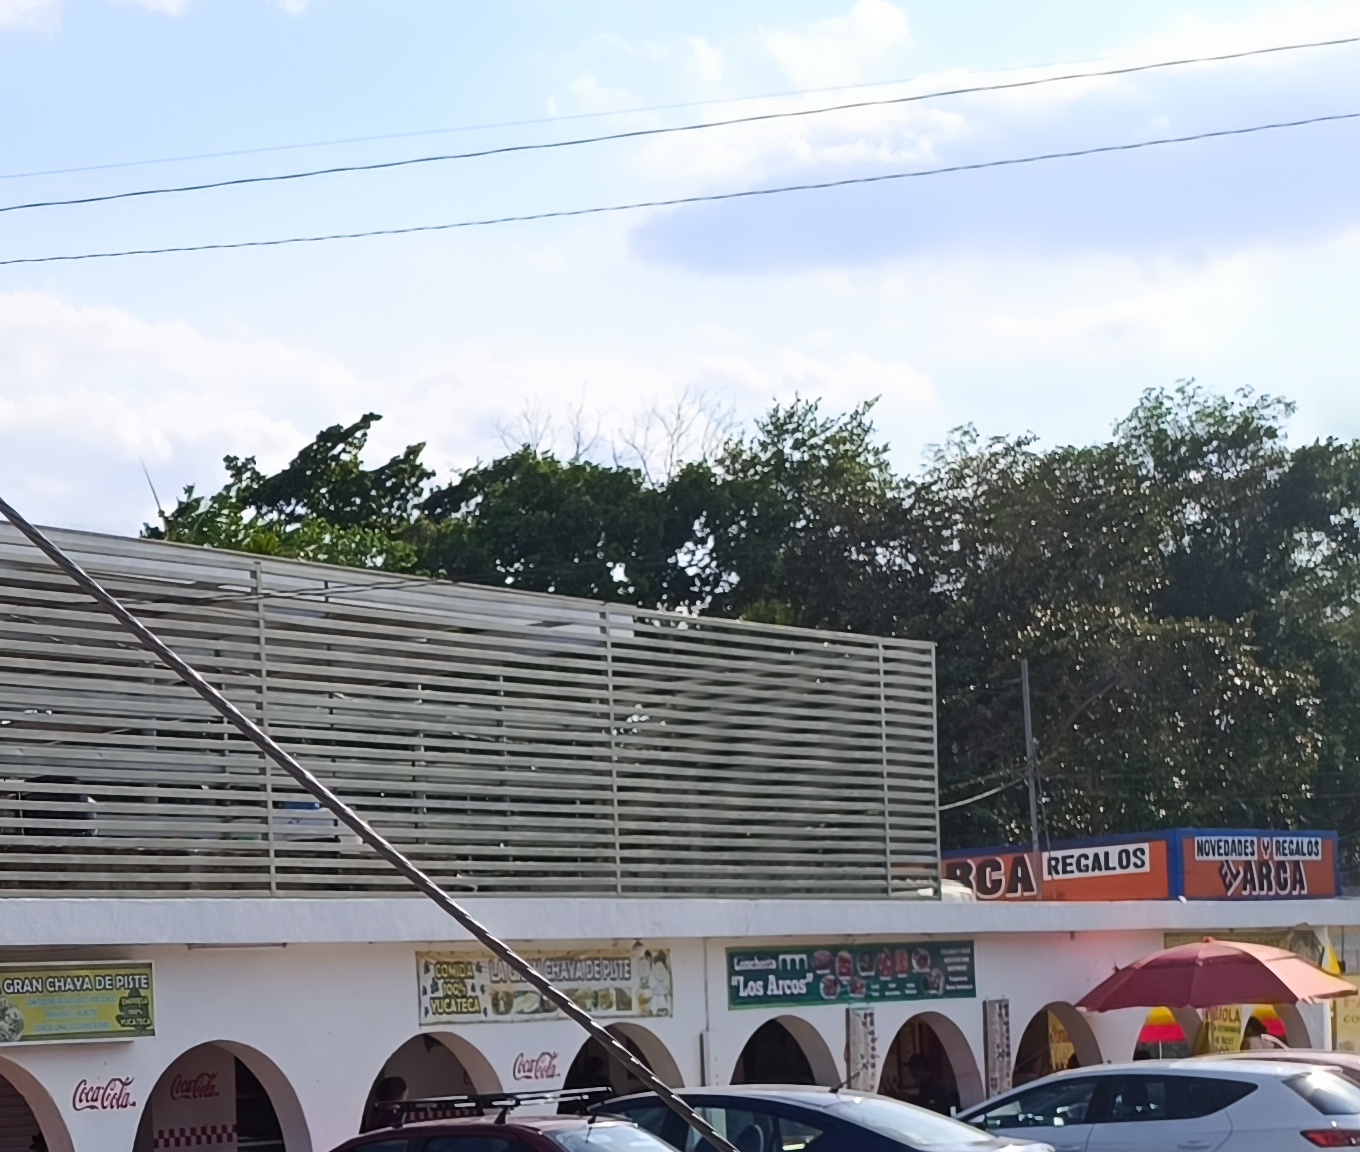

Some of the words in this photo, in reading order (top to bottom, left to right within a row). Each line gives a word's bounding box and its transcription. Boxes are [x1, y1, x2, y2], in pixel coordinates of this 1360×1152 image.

[1197, 838, 1256, 857] NOVEDADES
[1261, 838, 1271, 858] Y
[1275, 838, 1320, 857] REGALOS
[1047, 847, 1146, 876] REGALOS
[946, 854, 1038, 899] RCA
[1242, 859, 1308, 896] ARCA
[434, 962, 475, 979] COMIDA
[544, 958, 584, 982] CHAYA
[584, 957, 600, 981] DE
[2, 976, 43, 994] GRAN
[46, 975, 93, 993] CHAYA
[94, 974, 114, 991] DE
[115, 973, 149, 990] PISTE
[430, 996, 481, 1015] YUCATECA
[73, 1077, 135, 1111] Coca-Cola
